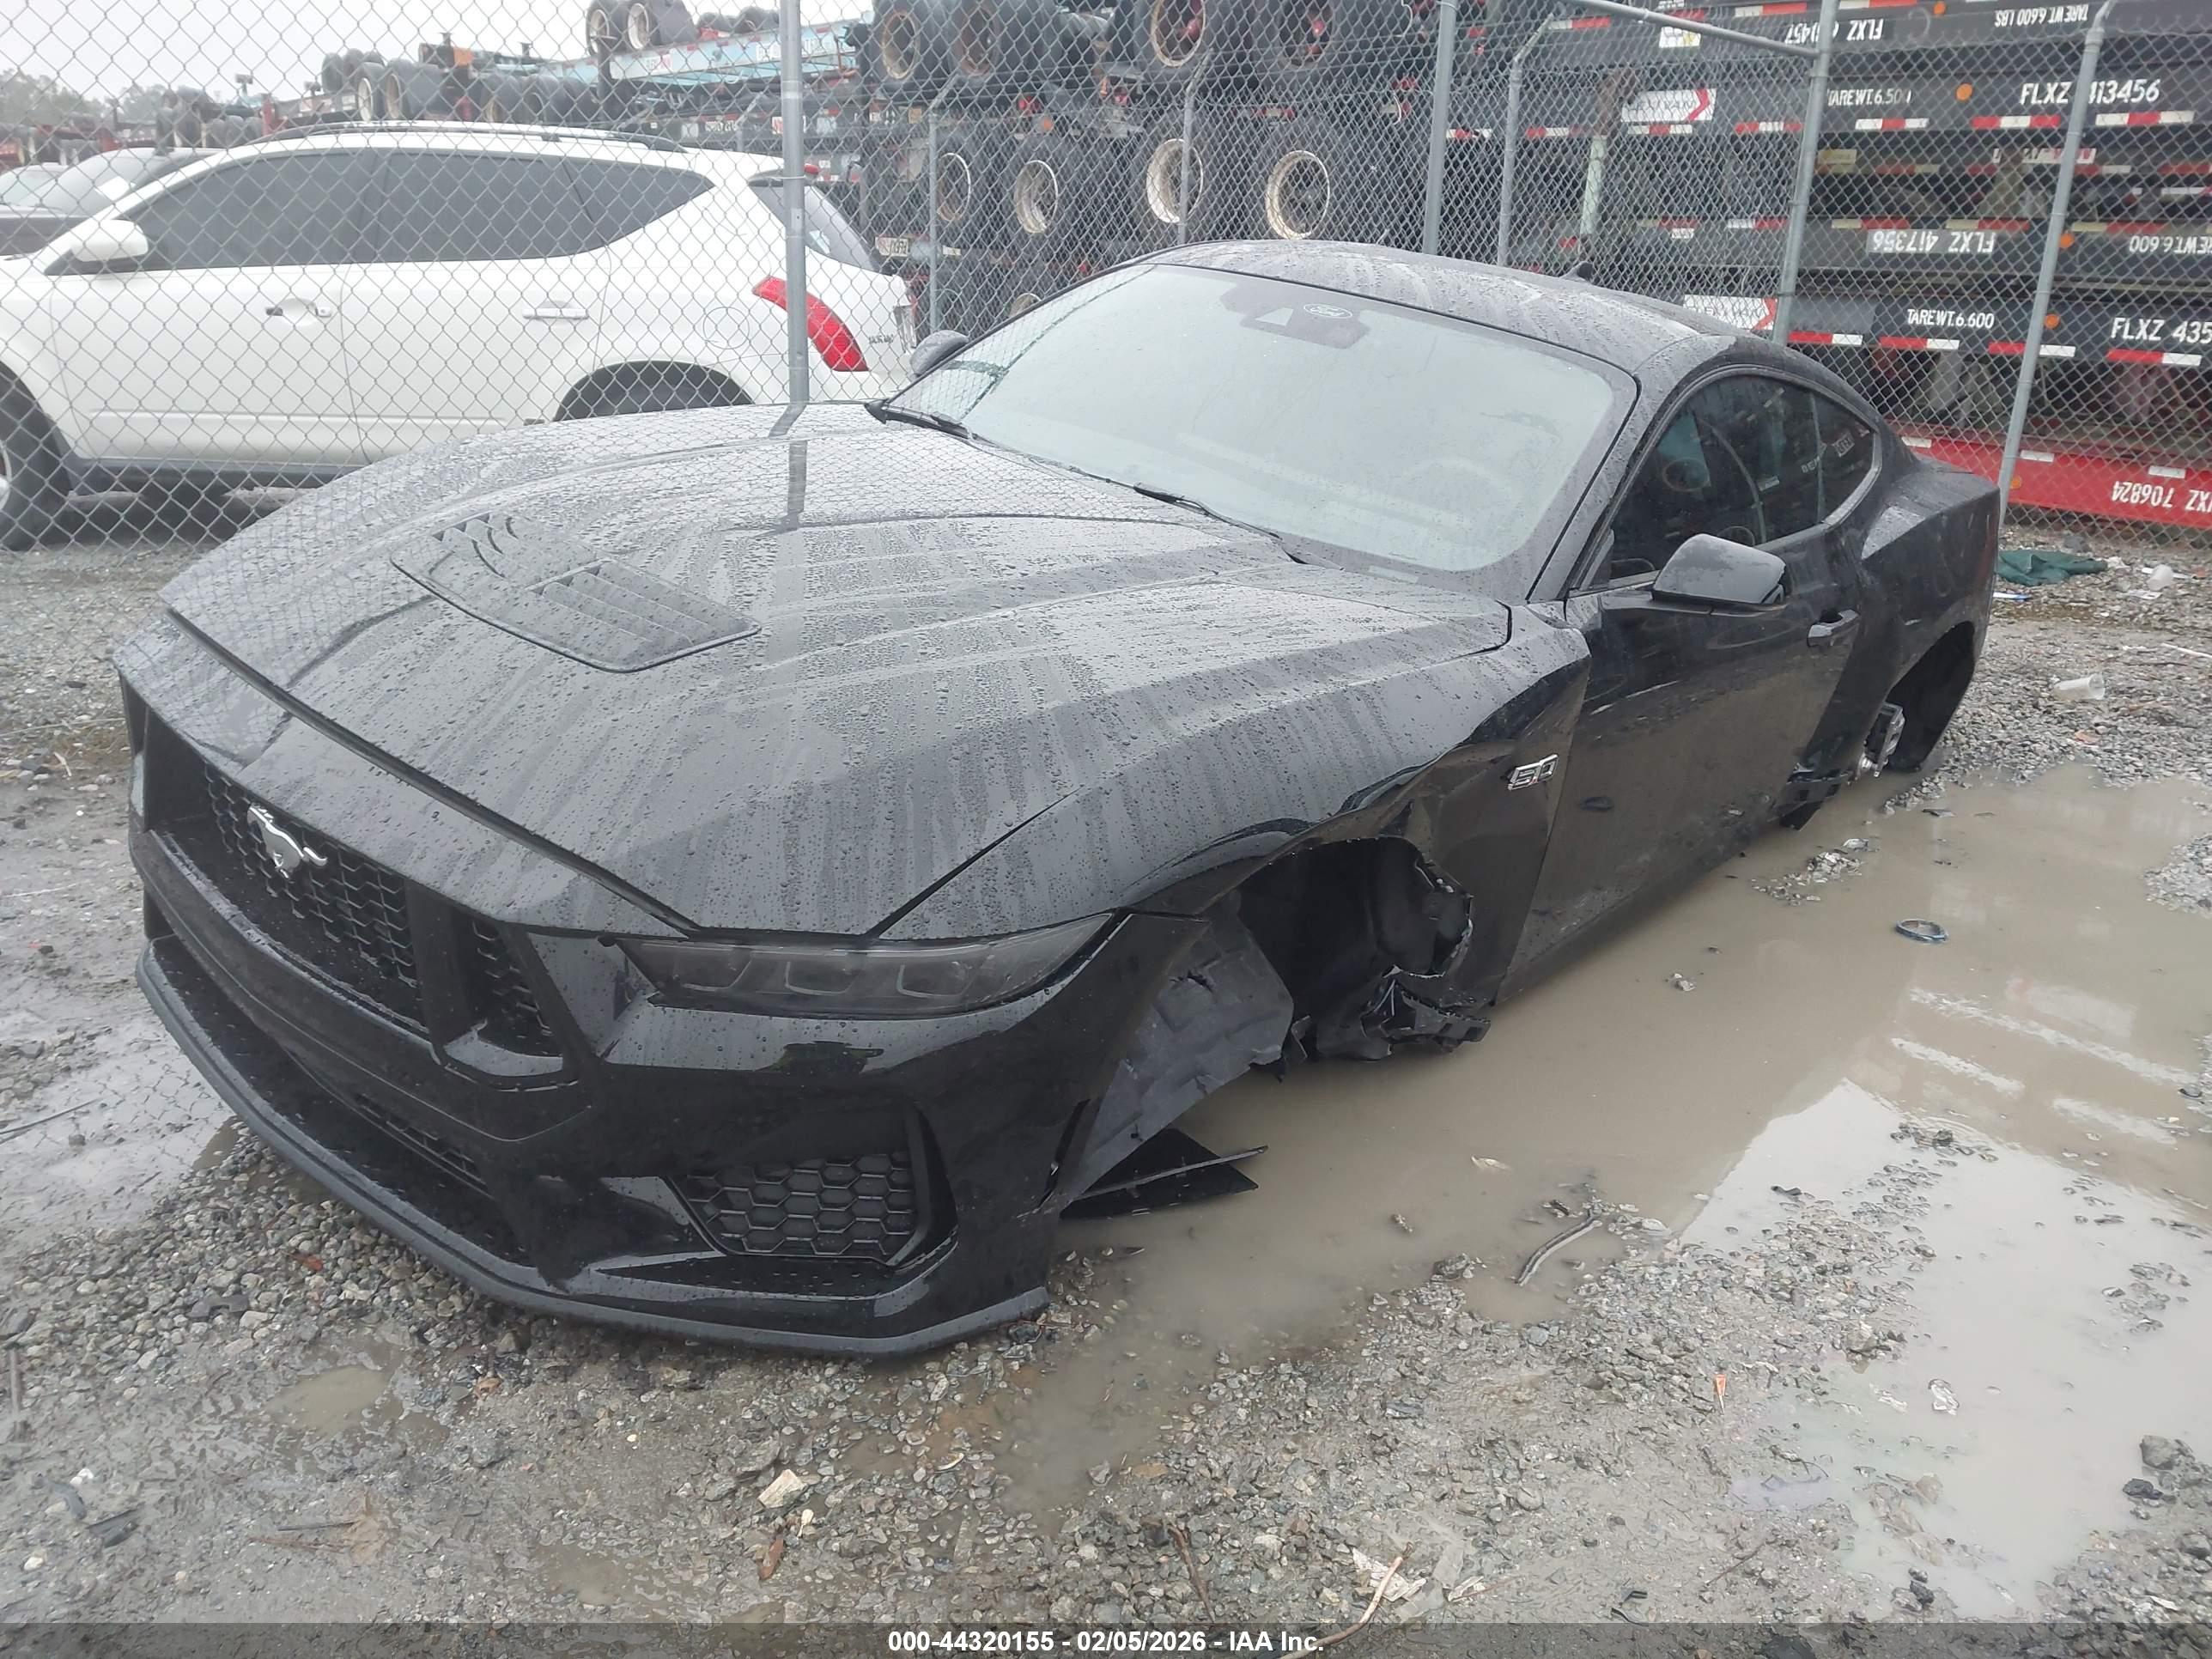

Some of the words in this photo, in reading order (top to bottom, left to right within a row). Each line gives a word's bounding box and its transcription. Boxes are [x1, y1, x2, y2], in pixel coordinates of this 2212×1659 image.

[1846, 19, 1884, 41] FLXZ
[2019, 81, 2072, 106] FLXZ
[1948, 231, 1996, 253] FLXZ
[2111, 317, 2166, 342] FLXZ
[2112, 480, 2175, 508] 706824
